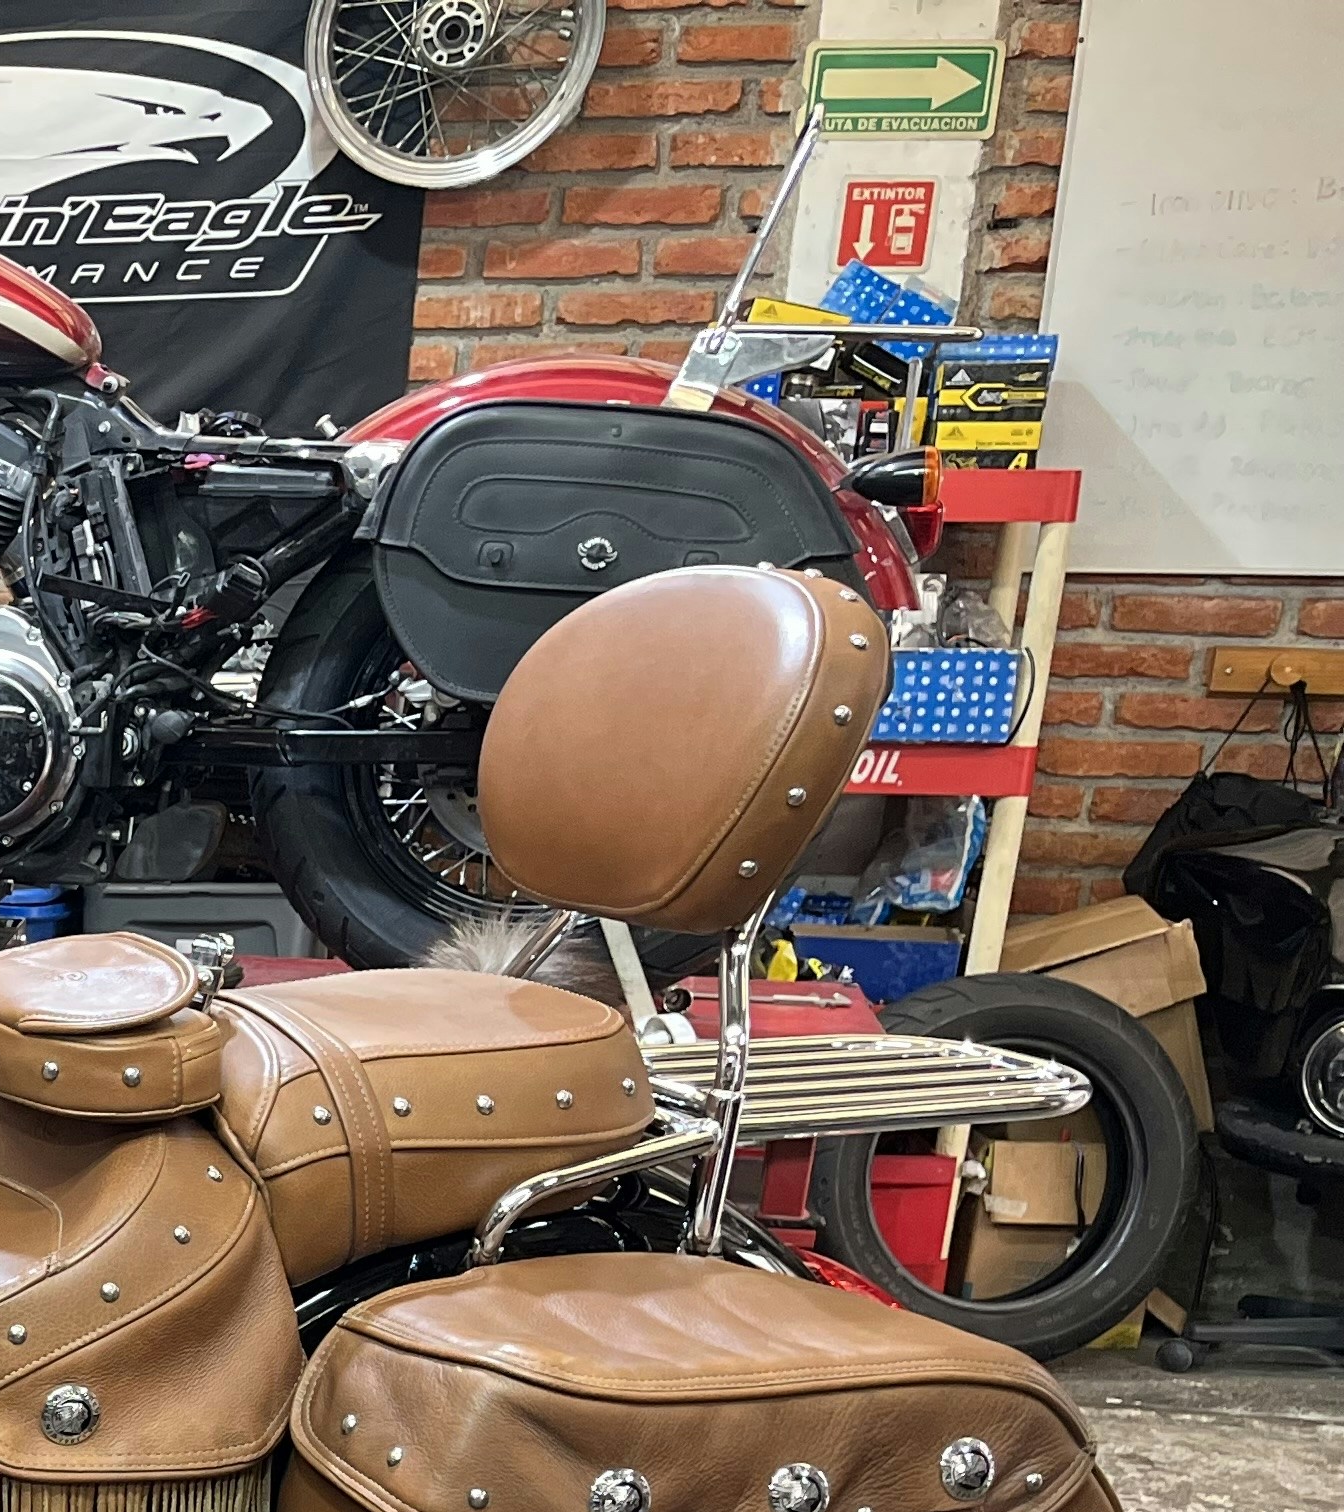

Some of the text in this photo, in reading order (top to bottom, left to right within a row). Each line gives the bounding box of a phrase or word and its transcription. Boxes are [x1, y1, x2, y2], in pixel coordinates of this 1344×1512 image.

[820, 118, 978, 131] UTA DE EVACUACION
[852, 187, 925, 200] EXTINTOR
